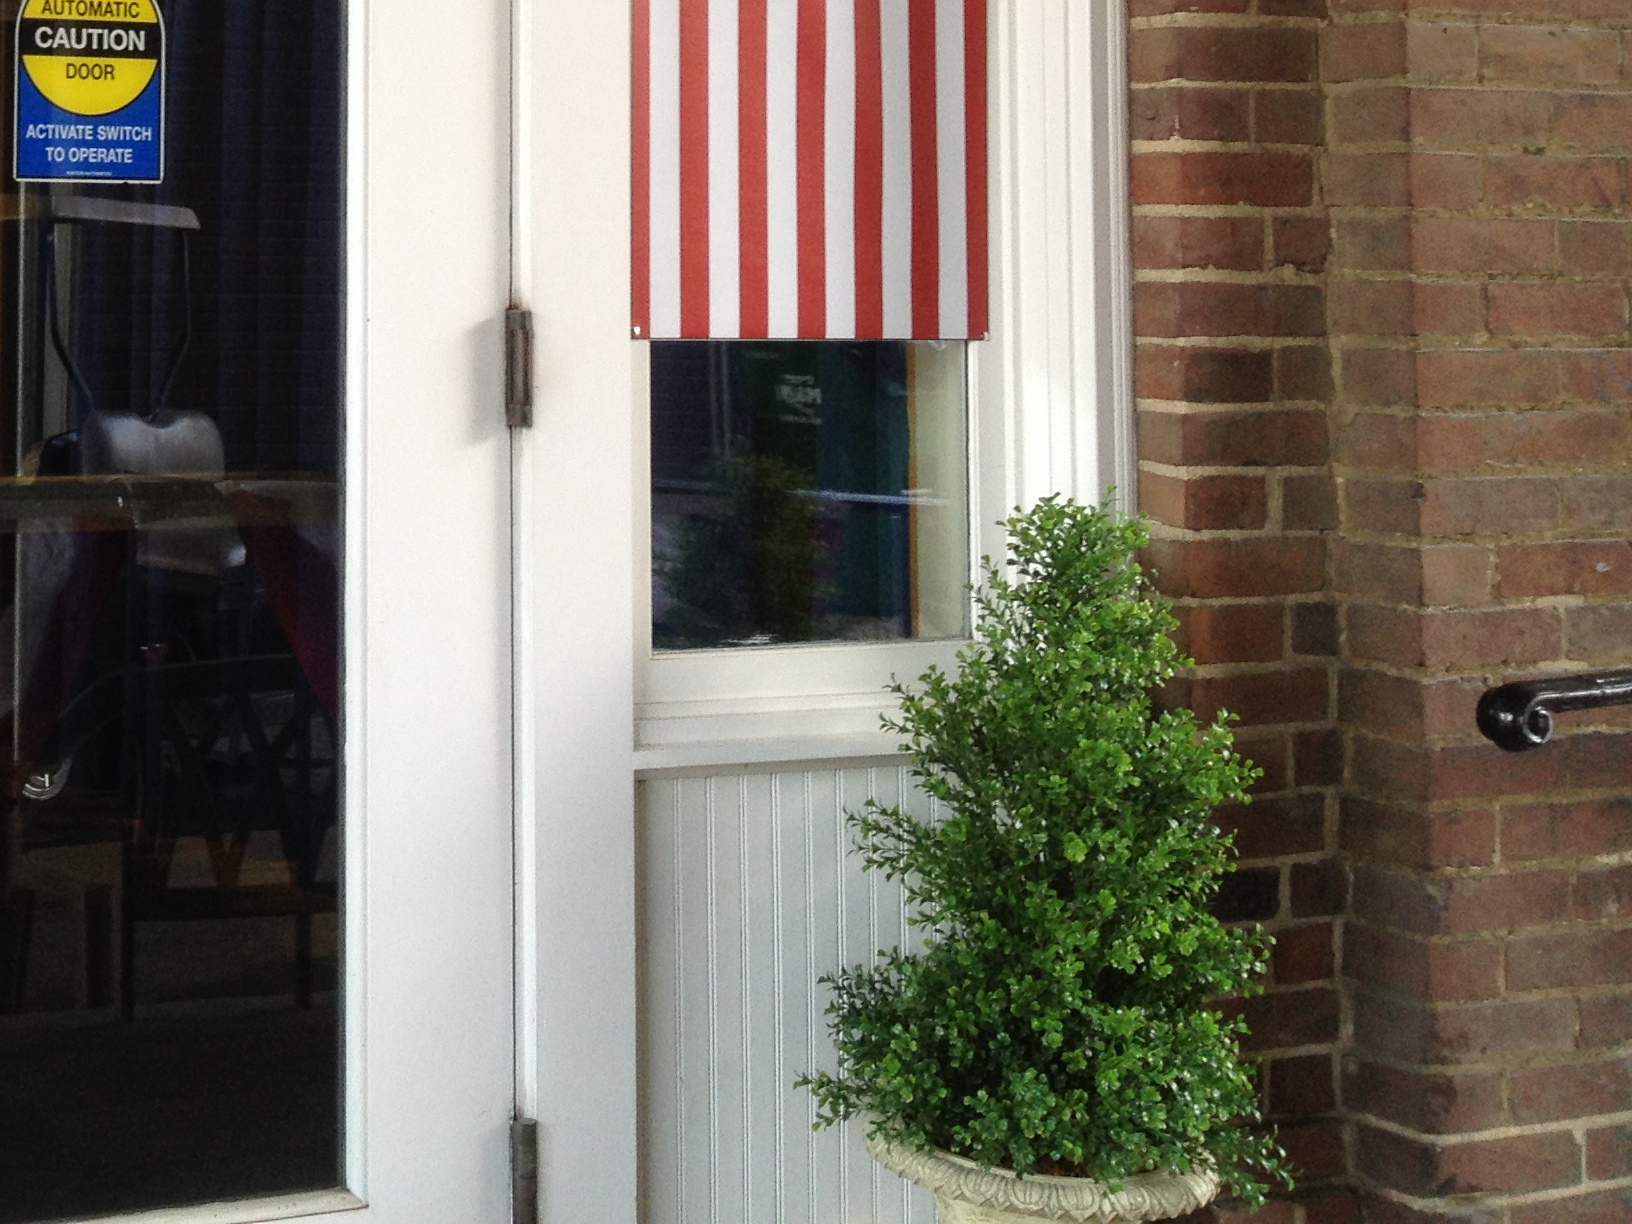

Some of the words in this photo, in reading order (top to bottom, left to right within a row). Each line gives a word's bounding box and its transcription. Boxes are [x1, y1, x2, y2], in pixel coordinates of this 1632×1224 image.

[34, 26, 146, 52] CAUTION
[65, 62, 115, 81] DOOR
[25, 123, 94, 141] ACTIVATE
[96, 125, 152, 142] SWITCH
[45, 146, 66, 163] TO
[69, 147, 134, 164] OPERATE
